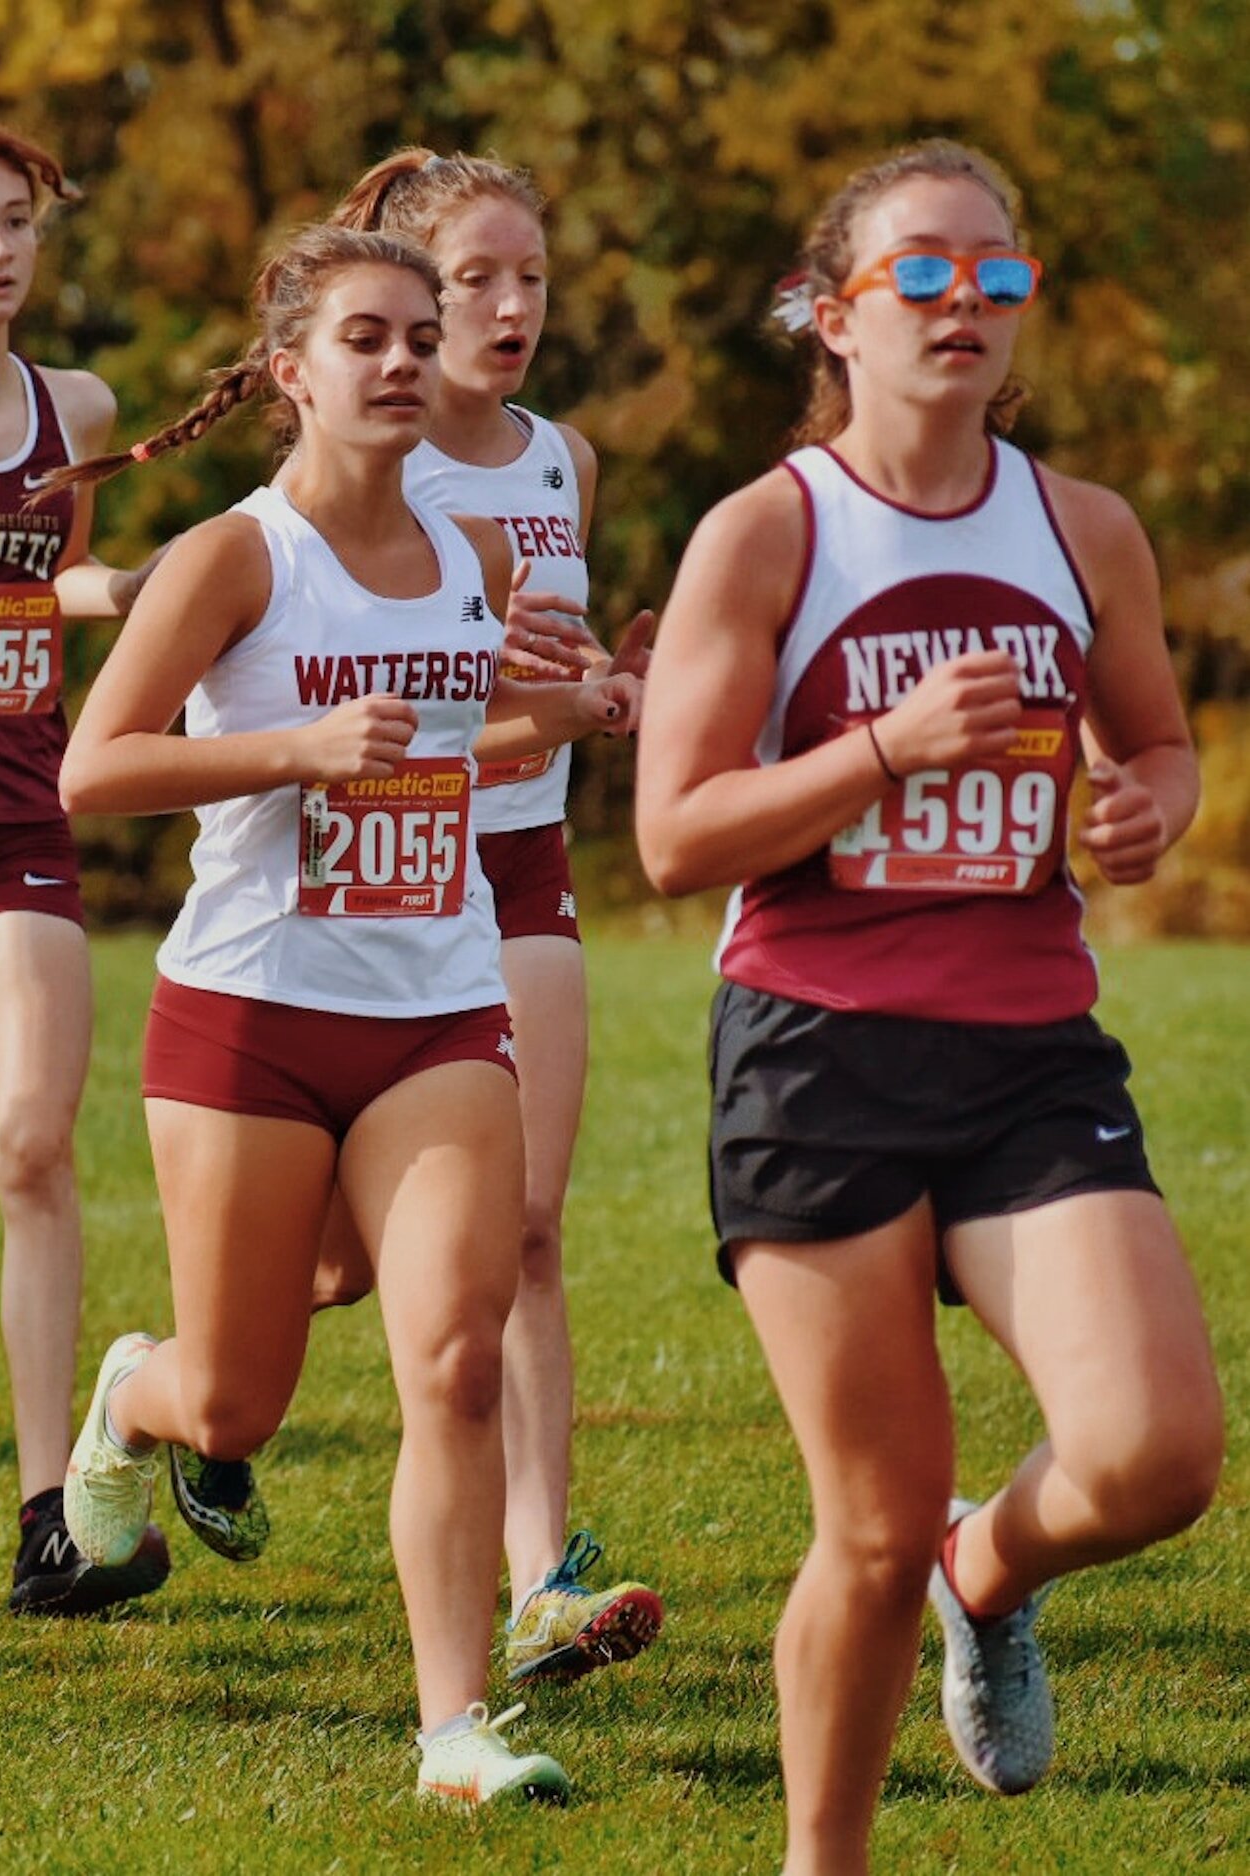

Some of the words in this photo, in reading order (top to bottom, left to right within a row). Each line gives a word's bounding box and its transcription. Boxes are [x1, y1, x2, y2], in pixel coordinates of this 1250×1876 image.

[294, 650, 498, 706] WATTERSO
[314, 772, 431, 797] thletic
[858, 769, 1057, 857] 1599
[320, 810, 461, 886] 2055
[956, 863, 1009, 880] FIRST
[401, 893, 431, 906] FIRST
[39, 1530, 76, 1566] N
